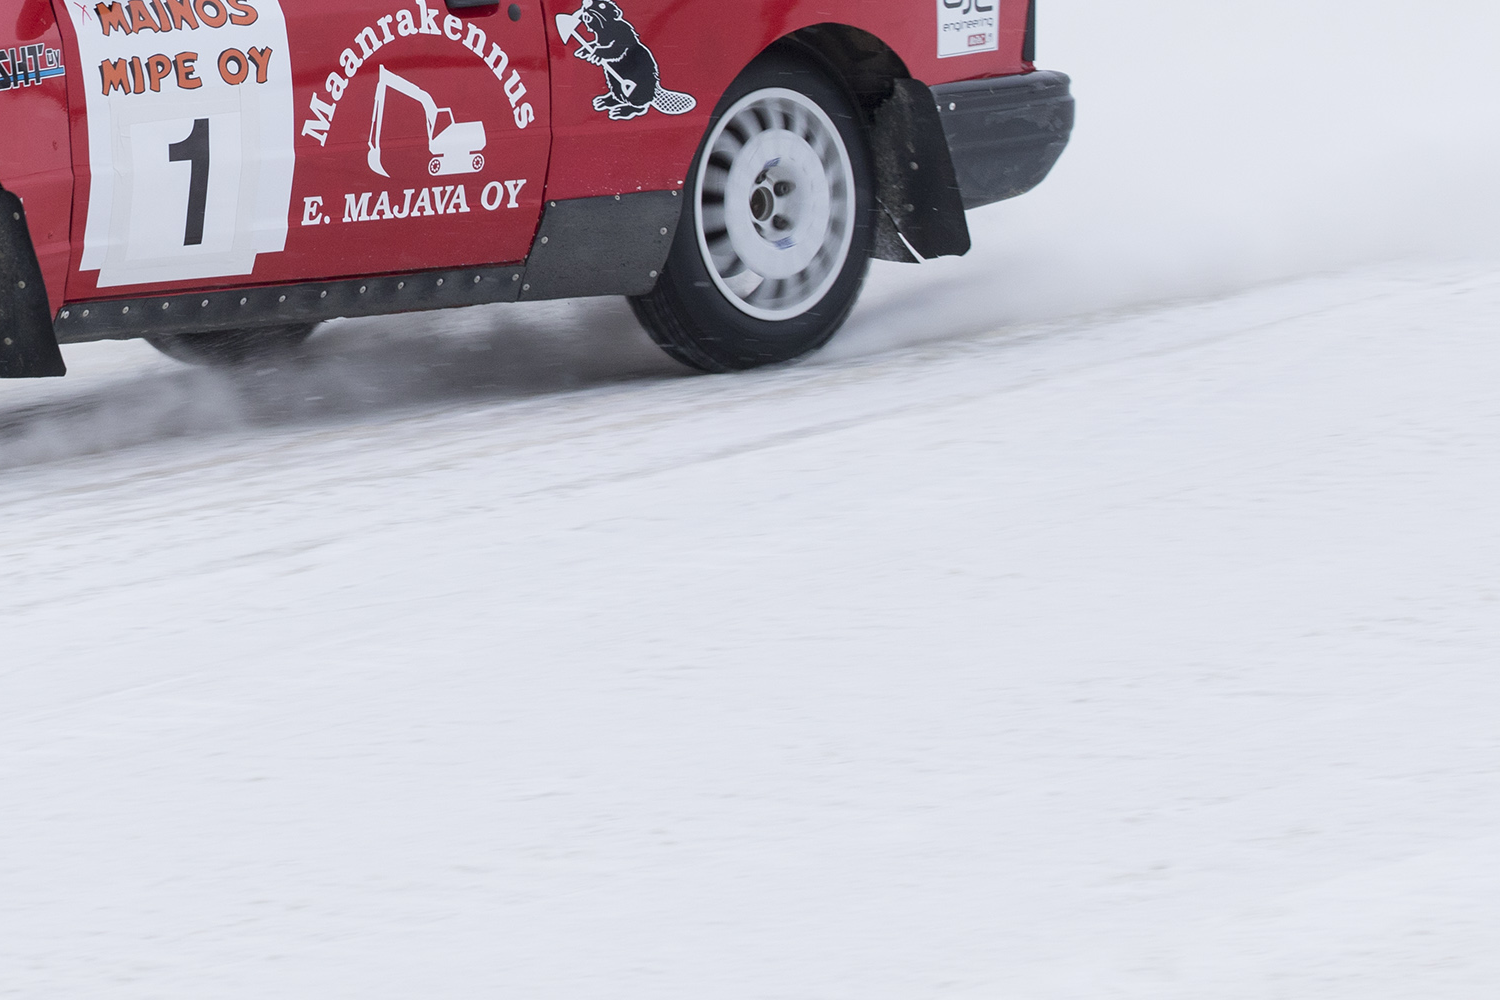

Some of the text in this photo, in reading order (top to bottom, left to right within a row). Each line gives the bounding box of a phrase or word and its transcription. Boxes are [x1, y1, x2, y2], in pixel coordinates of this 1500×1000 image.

[99, 46, 273, 96] MIPE OY
[169, 118, 209, 246] 1
[301, 179, 527, 226] E. MAJAVA OY
